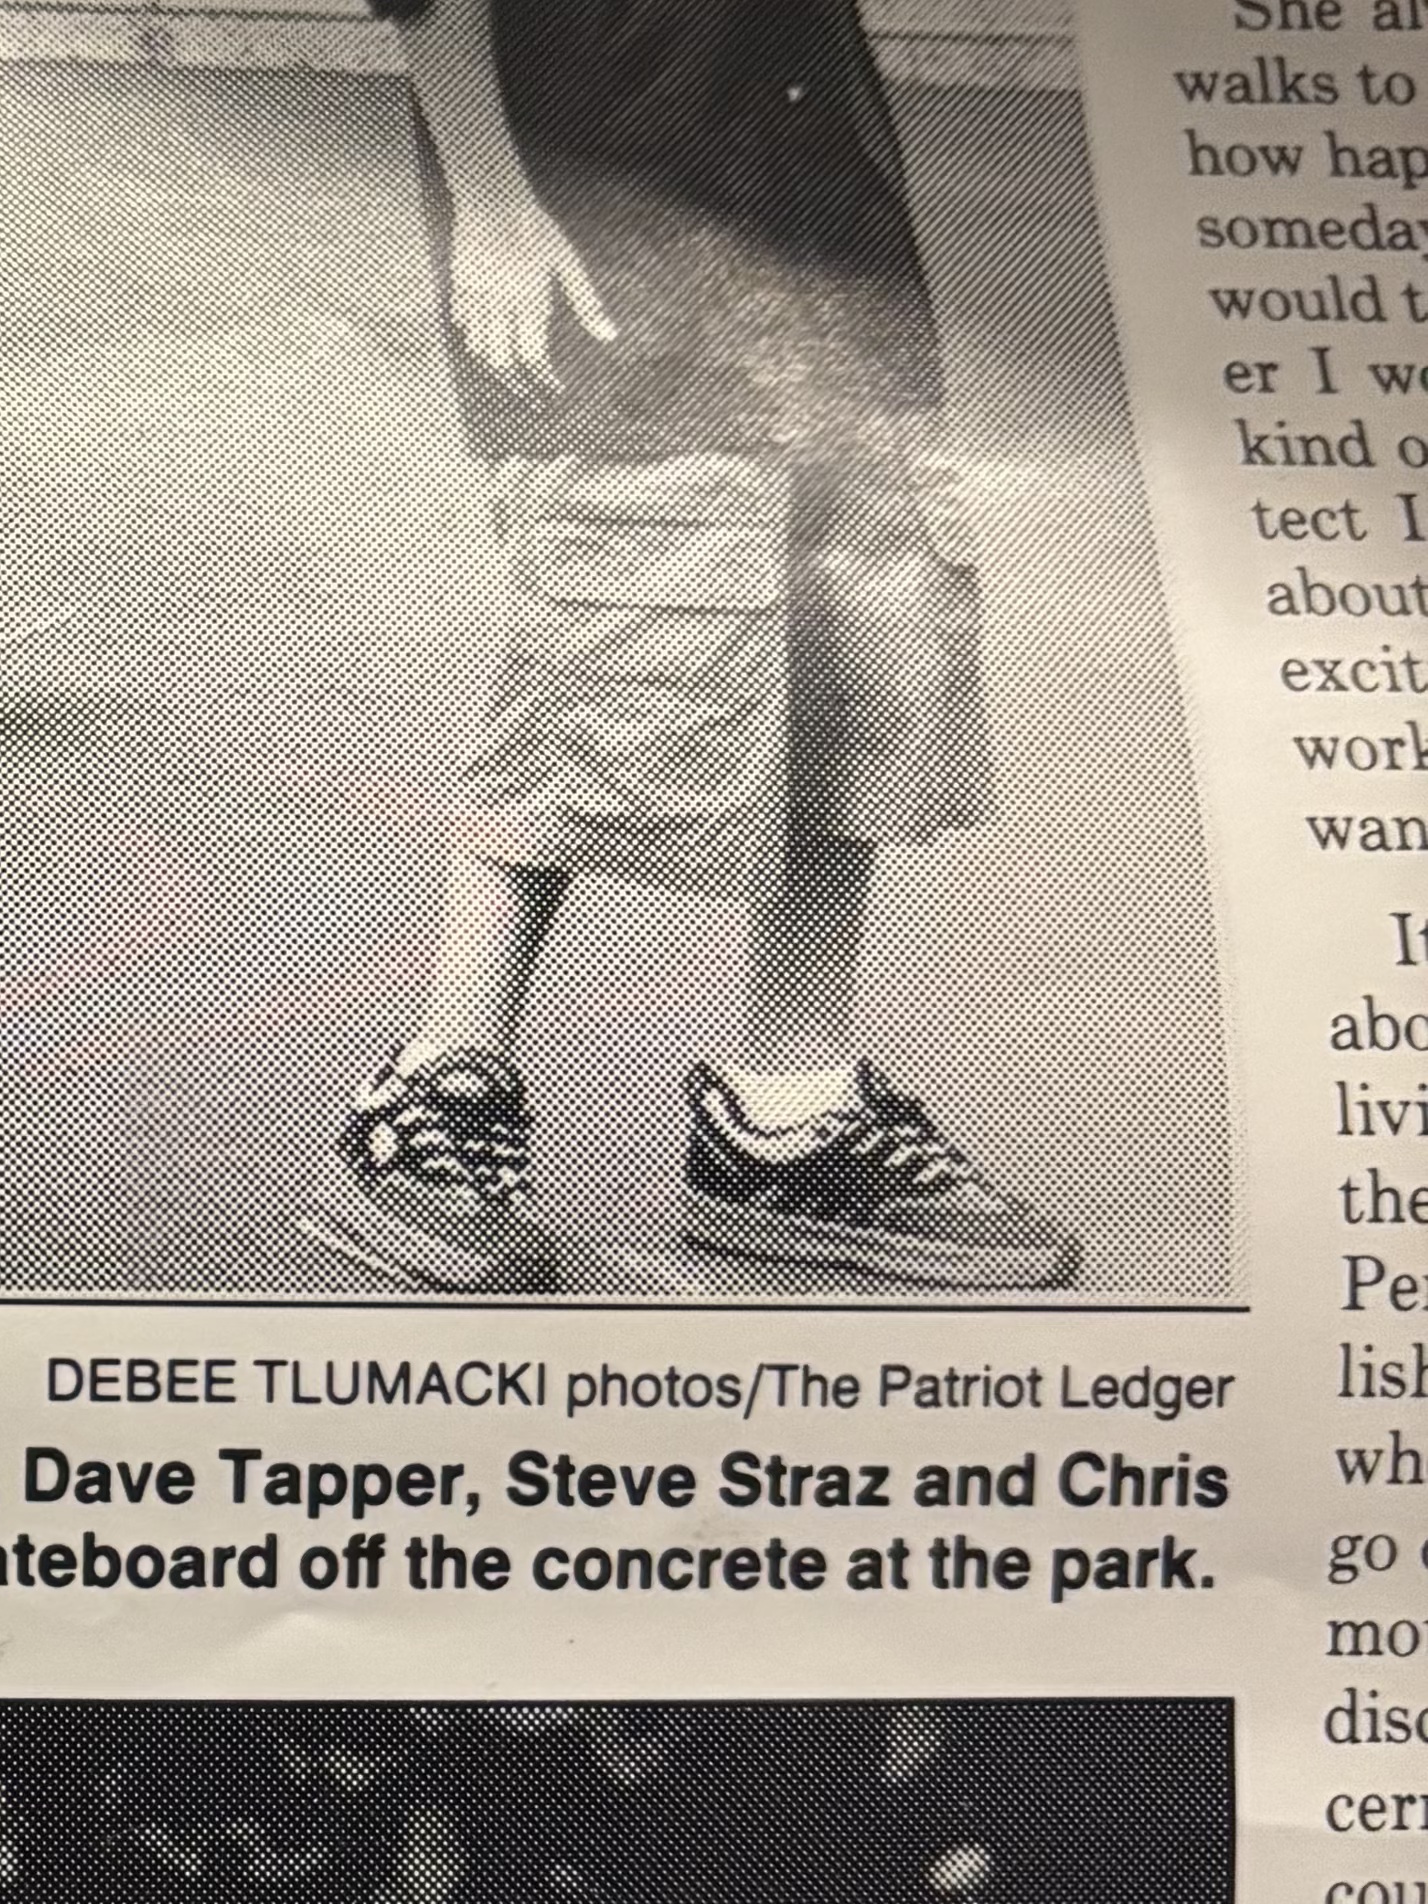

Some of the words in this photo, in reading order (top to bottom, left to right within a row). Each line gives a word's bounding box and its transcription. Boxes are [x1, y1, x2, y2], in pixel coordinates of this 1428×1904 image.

[1173, 54, 1340, 106] walks
[1355, 59, 1417, 106] to
[1266, 564, 1428, 618] about
[47, 1358, 236, 1404] DEBEE
[253, 1360, 546, 1406] TLUMACKI
[567, 1363, 860, 1420] photos/The
[880, 1364, 1043, 1409] Patriot
[1061, 1365, 1236, 1421] Ledger
[25, 1447, 195, 1504] Dave
[219, 1448, 479, 1519] Tapper,
[507, 1450, 696, 1508] Steve
[720, 1451, 890, 1508] Straz
[914, 1453, 1036, 1508] and
[1059, 1451, 1229, 1509] Chris
[300, 1533, 386, 1590] off
[405, 1534, 511, 1591] the
[533, 1538, 827, 1592] concrete
[847, 1538, 910, 1591] at
[929, 1535, 1031, 1591] the
[1052, 1535, 1214, 1603] park.
